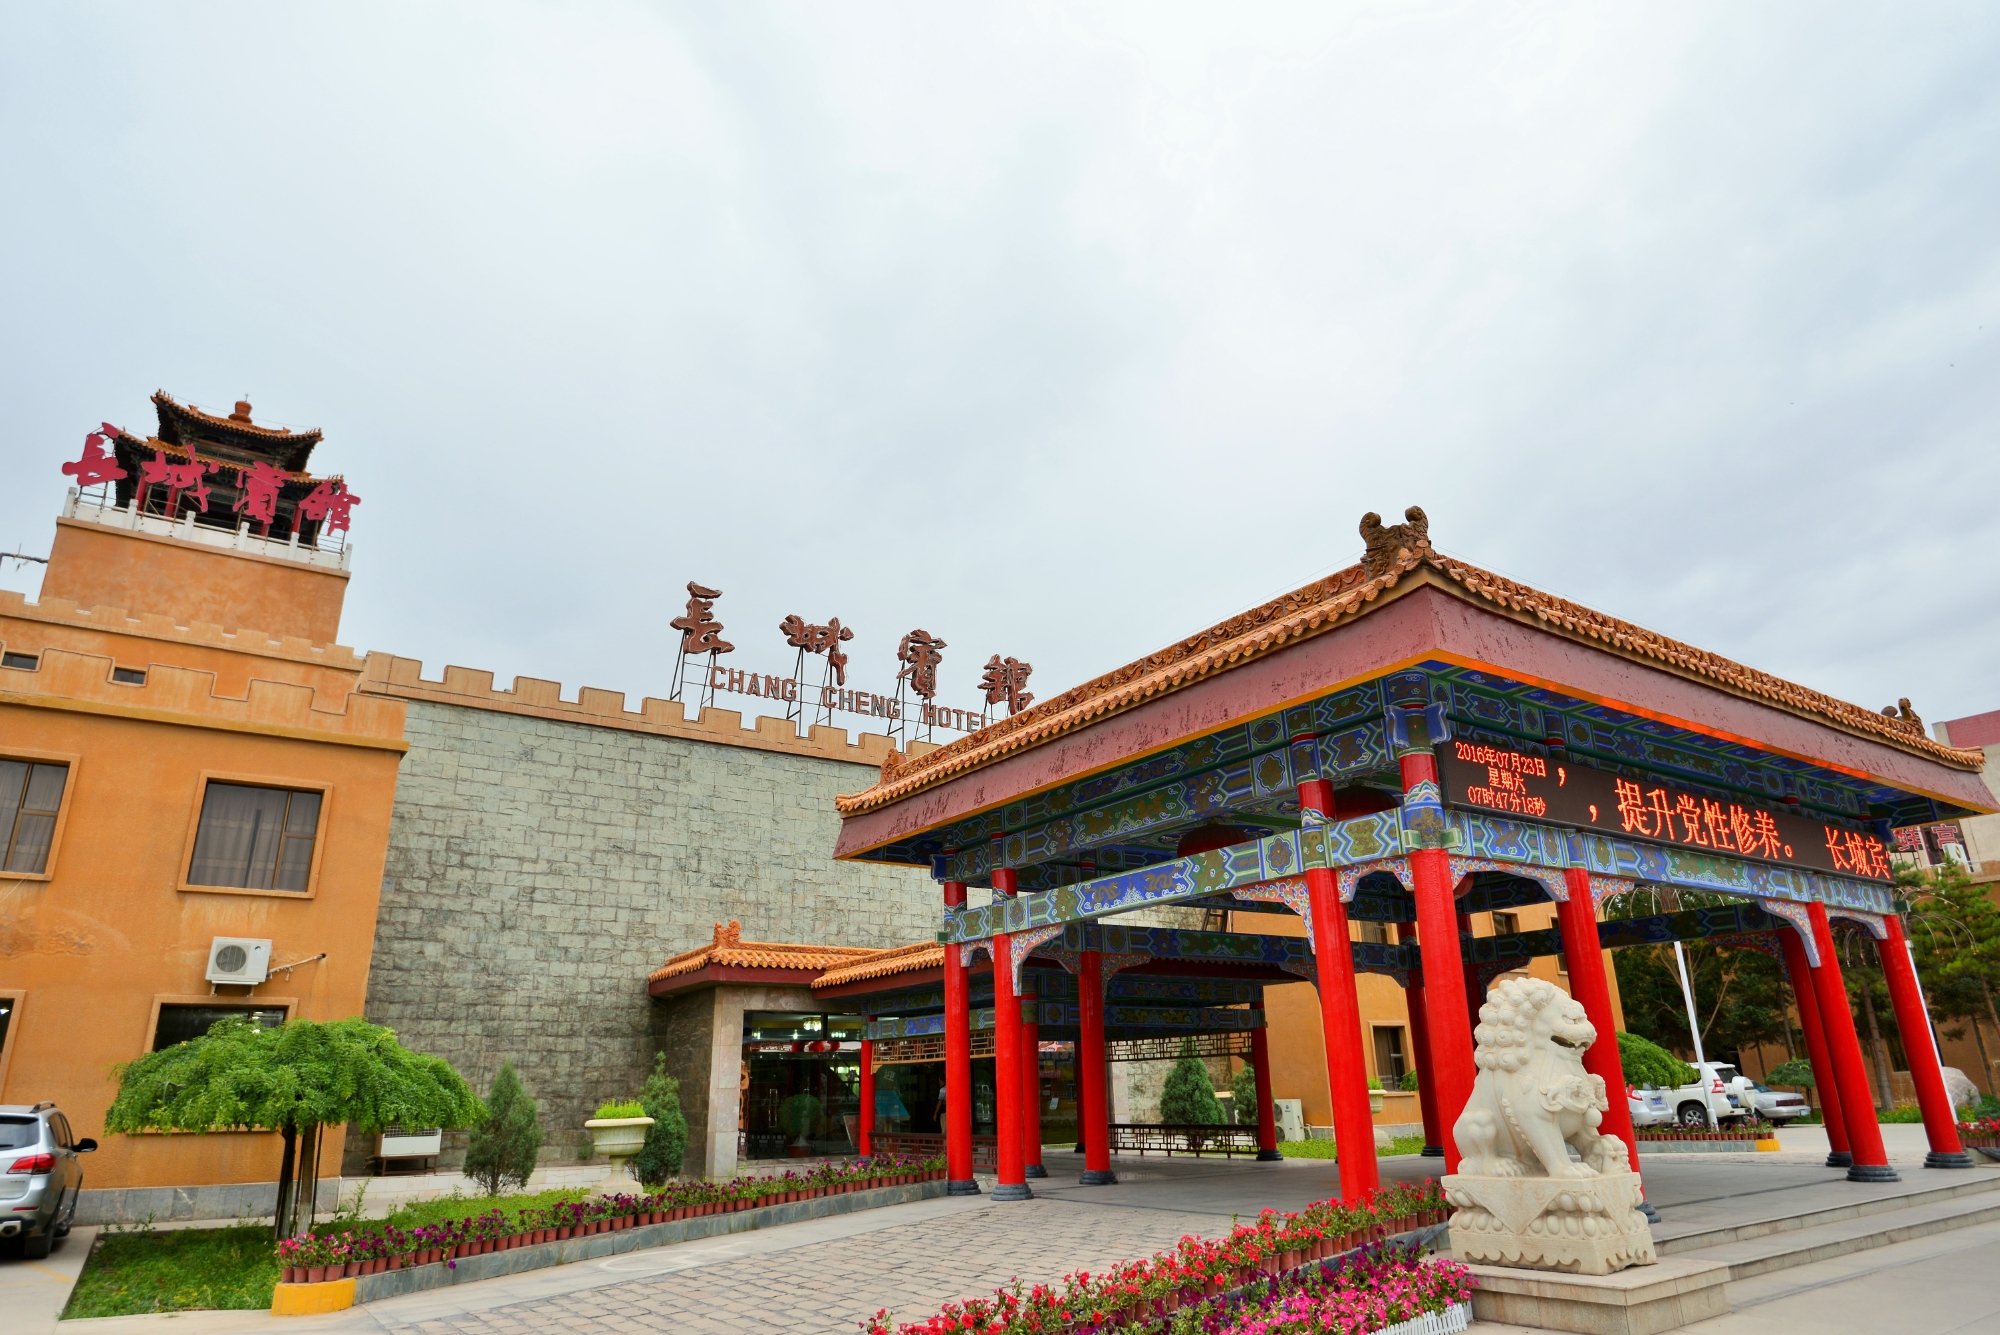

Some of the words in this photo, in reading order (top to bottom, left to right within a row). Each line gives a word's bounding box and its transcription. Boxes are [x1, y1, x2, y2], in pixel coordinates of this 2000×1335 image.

[710, 665, 797, 701] CHANG
[822, 685, 901, 720] CHENG
[1455, 742, 1546, 777] 2016年07月23日
[1488, 767, 1526, 794] 星期六
[1467, 786, 1546, 816] 07时47分18秒
[1824, 825, 1891, 879] 长城宾
